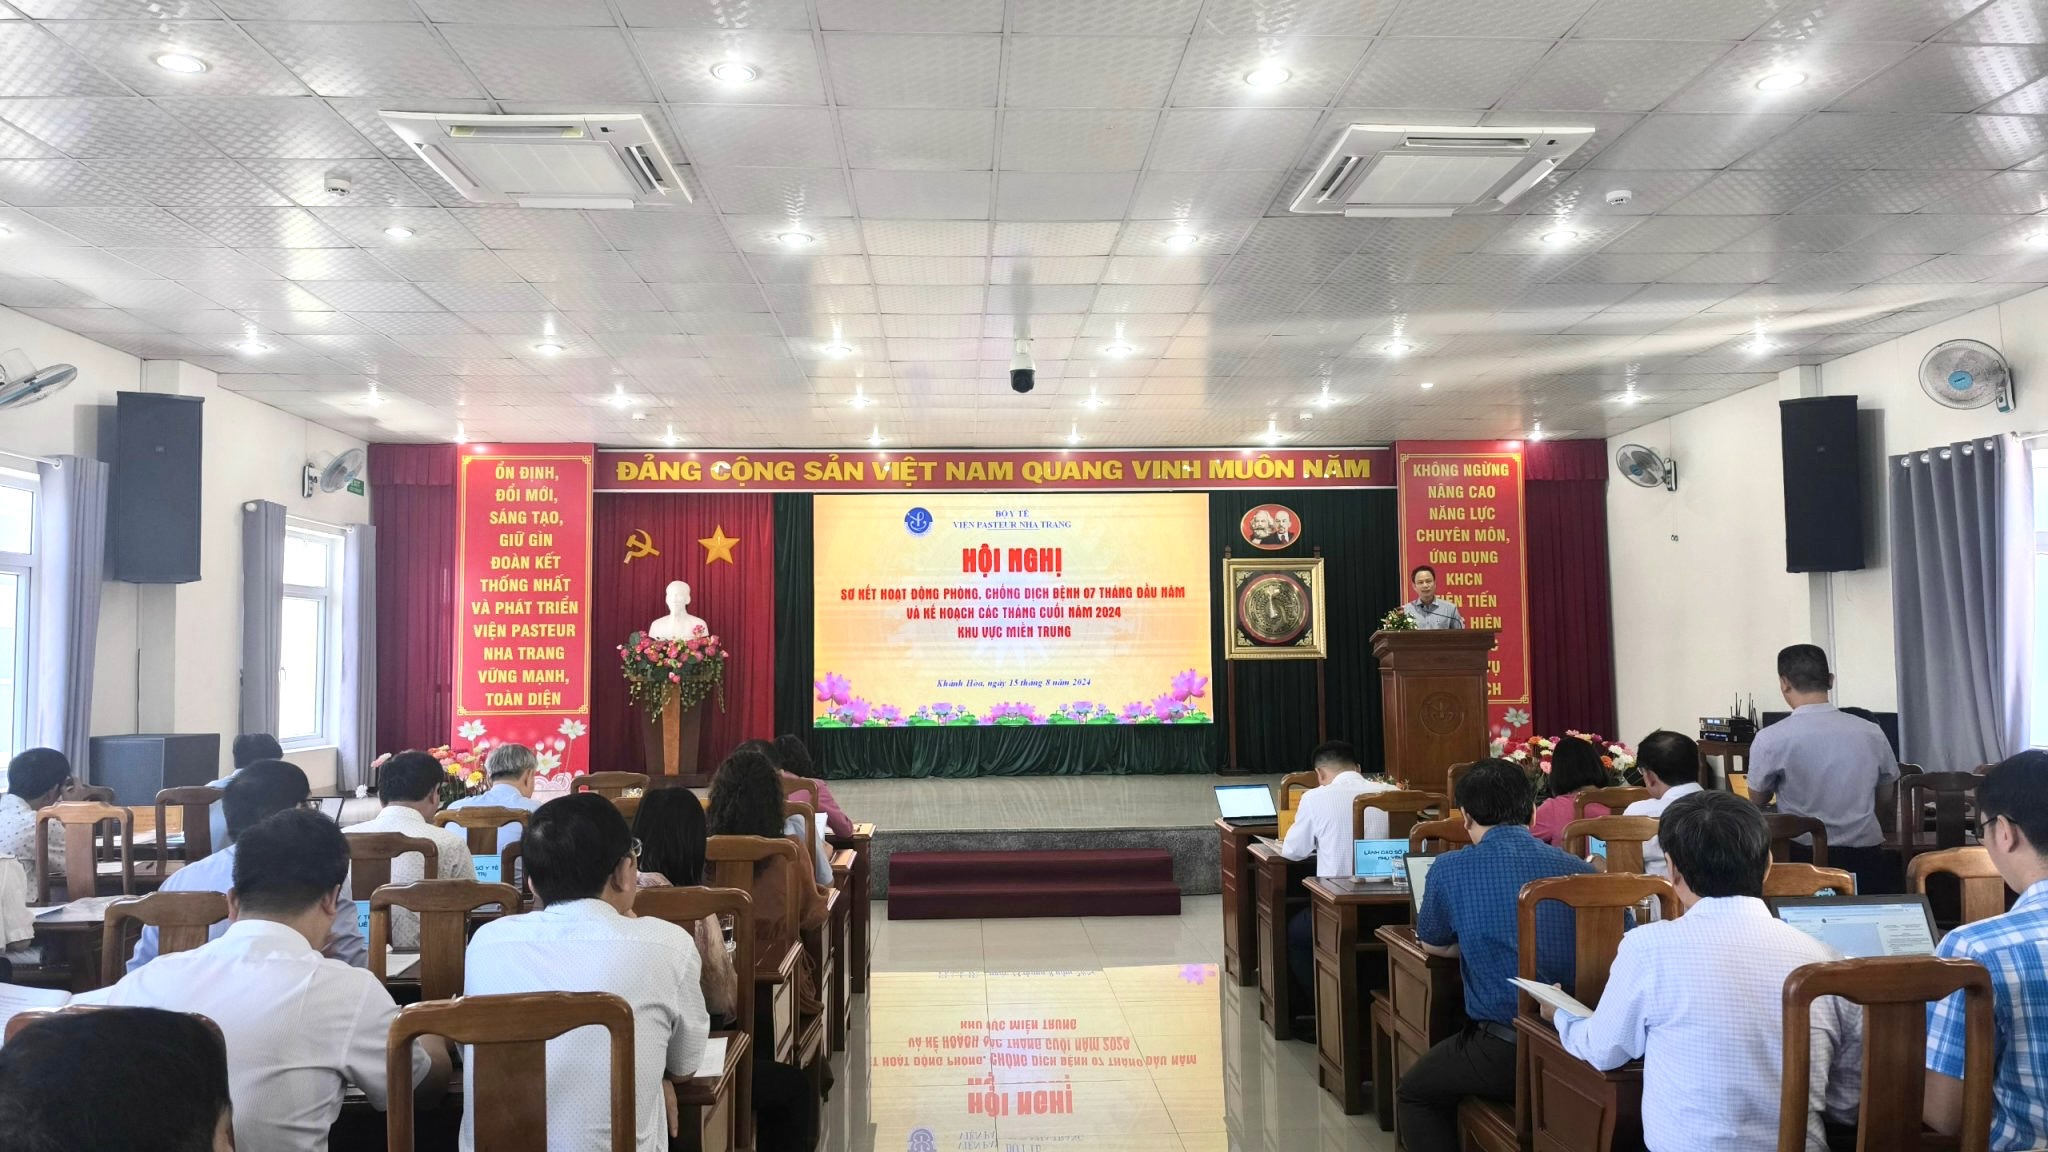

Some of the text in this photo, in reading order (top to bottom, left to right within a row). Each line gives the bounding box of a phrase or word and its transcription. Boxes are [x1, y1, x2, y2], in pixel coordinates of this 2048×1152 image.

[495, 460, 559, 483] ỔN ĐỊNH,
[616, 453, 1371, 487] ĐẢNG CỘNG SẢN VIỆT NAM QUANG VINH MUÔN NĂM
[1414, 461, 1510, 478] KHÔNG NGỪNG
[495, 482, 558, 504] ĐỔI MỚI,
[1429, 482, 1496, 499] NÂNG CAO
[490, 508, 564, 527] SÁNG TẠO,
[1430, 504, 1496, 523] NĂNG LỰC
[1040, 520, 1072, 528] TRANG
[500, 530, 553, 547] GIỮ GÌN
[1417, 526, 1510, 544] CHUYÊN MÔN,
[490, 551, 561, 570] ĐOÀN KẾT
[963, 543, 1062, 578] HỘI NGHỊ
[1430, 549, 1499, 567] ỨNG DỤNG
[480, 573, 572, 593] THỐNG NHẤT
[1447, 572, 1483, 586] KHCN
[840, 587, 855, 600] SƠ
[858, 584, 877, 600] KẾT
[881, 588, 907, 602] HOẠT
[985, 584, 1020, 600] CHỐNG
[1024, 587, 1049, 601] DỊCH
[1053, 585, 1080, 601] BỆNH
[1083, 587, 1096, 599] 07
[1099, 585, 1132, 599] THÁNG
[1161, 585, 1185, 598] NĂM
[1467, 590, 1497, 608] TIẾN
[472, 595, 579, 615] VÀ PHÁT TRIỂN
[906, 602, 1121, 621] VÀ KẾ HOẠCH CÁC THÁNG CUỐI NĂM 2024
[474, 621, 576, 641] VIỆN PASTEUR
[957, 622, 1071, 640] KHU VỰC MIỀN TRUNG
[484, 646, 565, 661] NHA TRANG
[478, 667, 570, 686] VỮNG MẠNH,
[1009, 679, 1018, 687] 15
[1072, 678, 1092, 686] 2024
[486, 688, 561, 709] TOÀN DIỆN
